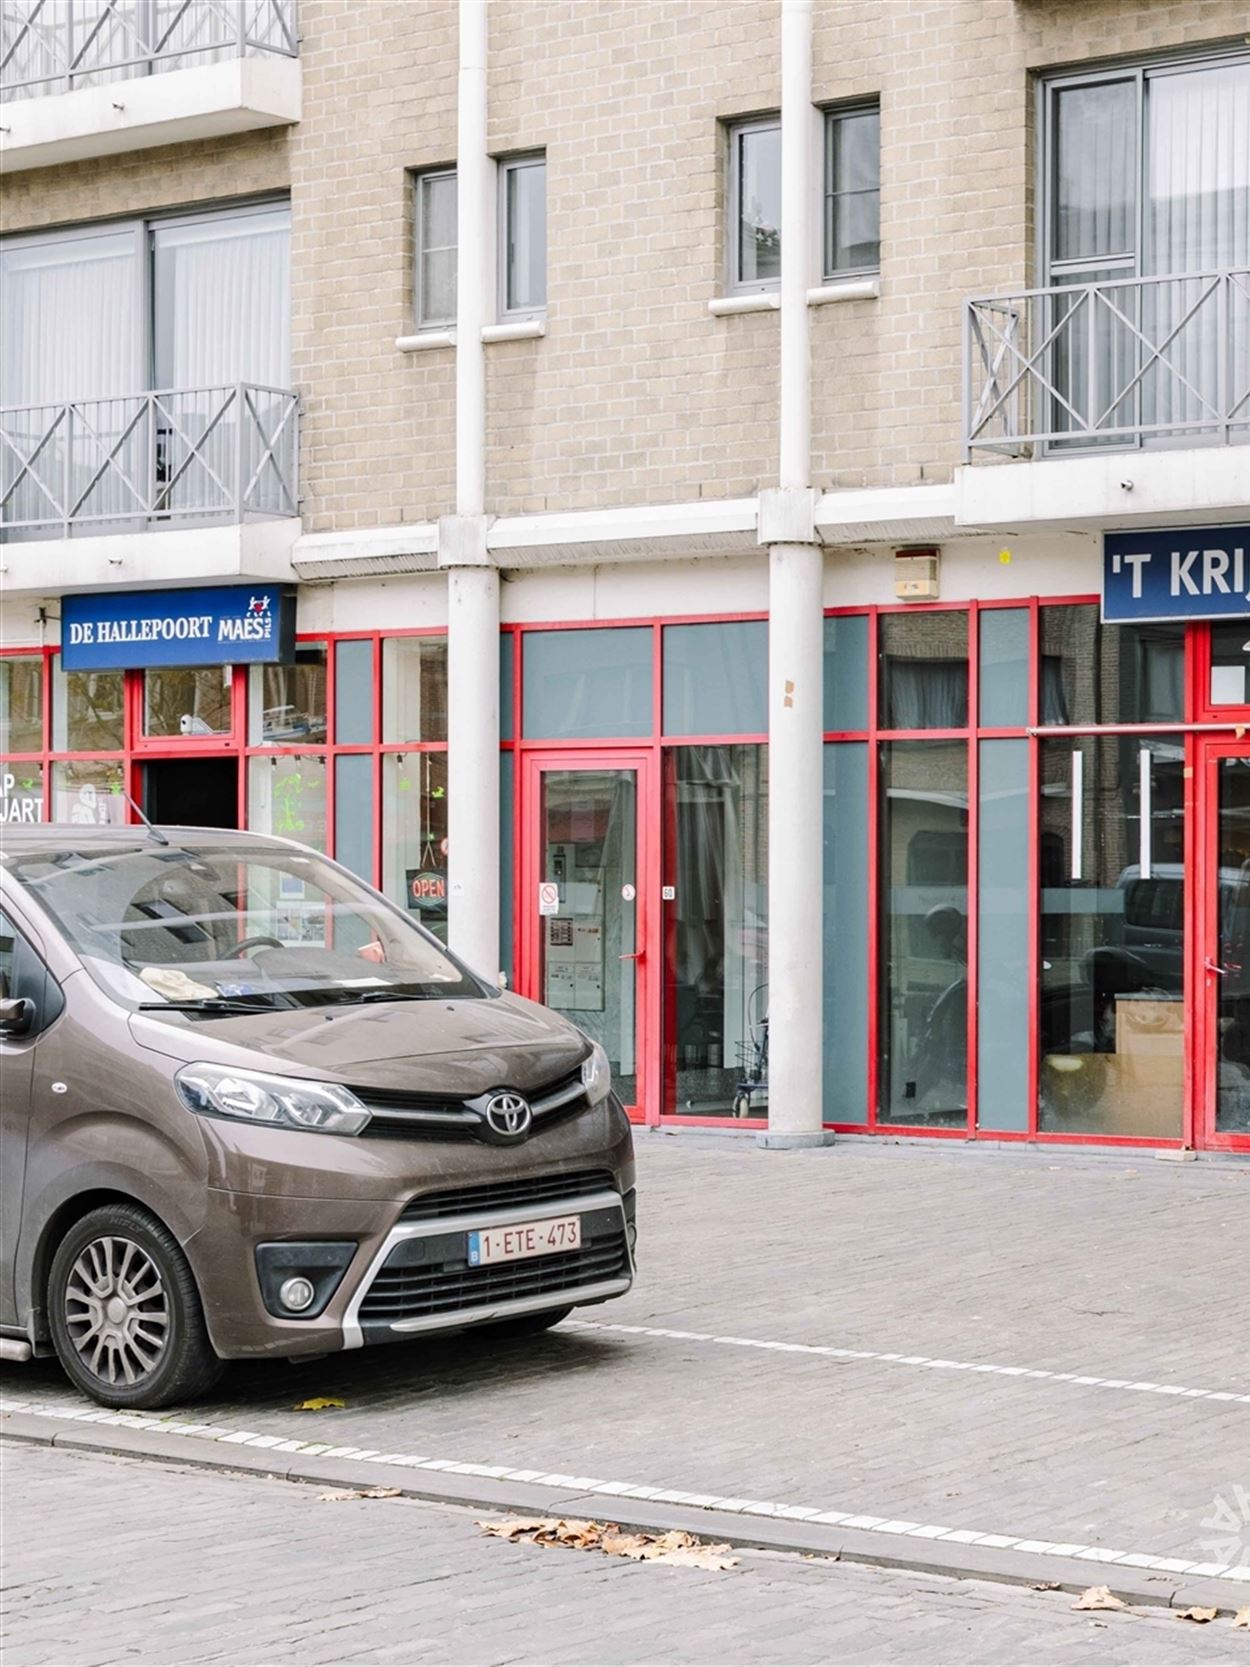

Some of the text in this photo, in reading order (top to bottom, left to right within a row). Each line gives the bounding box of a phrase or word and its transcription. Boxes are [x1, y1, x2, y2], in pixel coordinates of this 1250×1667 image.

[1112, 554, 1152, 598] 'T
[70, 616, 213, 645] DE HALLEPOORT
[218, 617, 264, 642] MAES
[412, 879, 445, 897] OPEN
